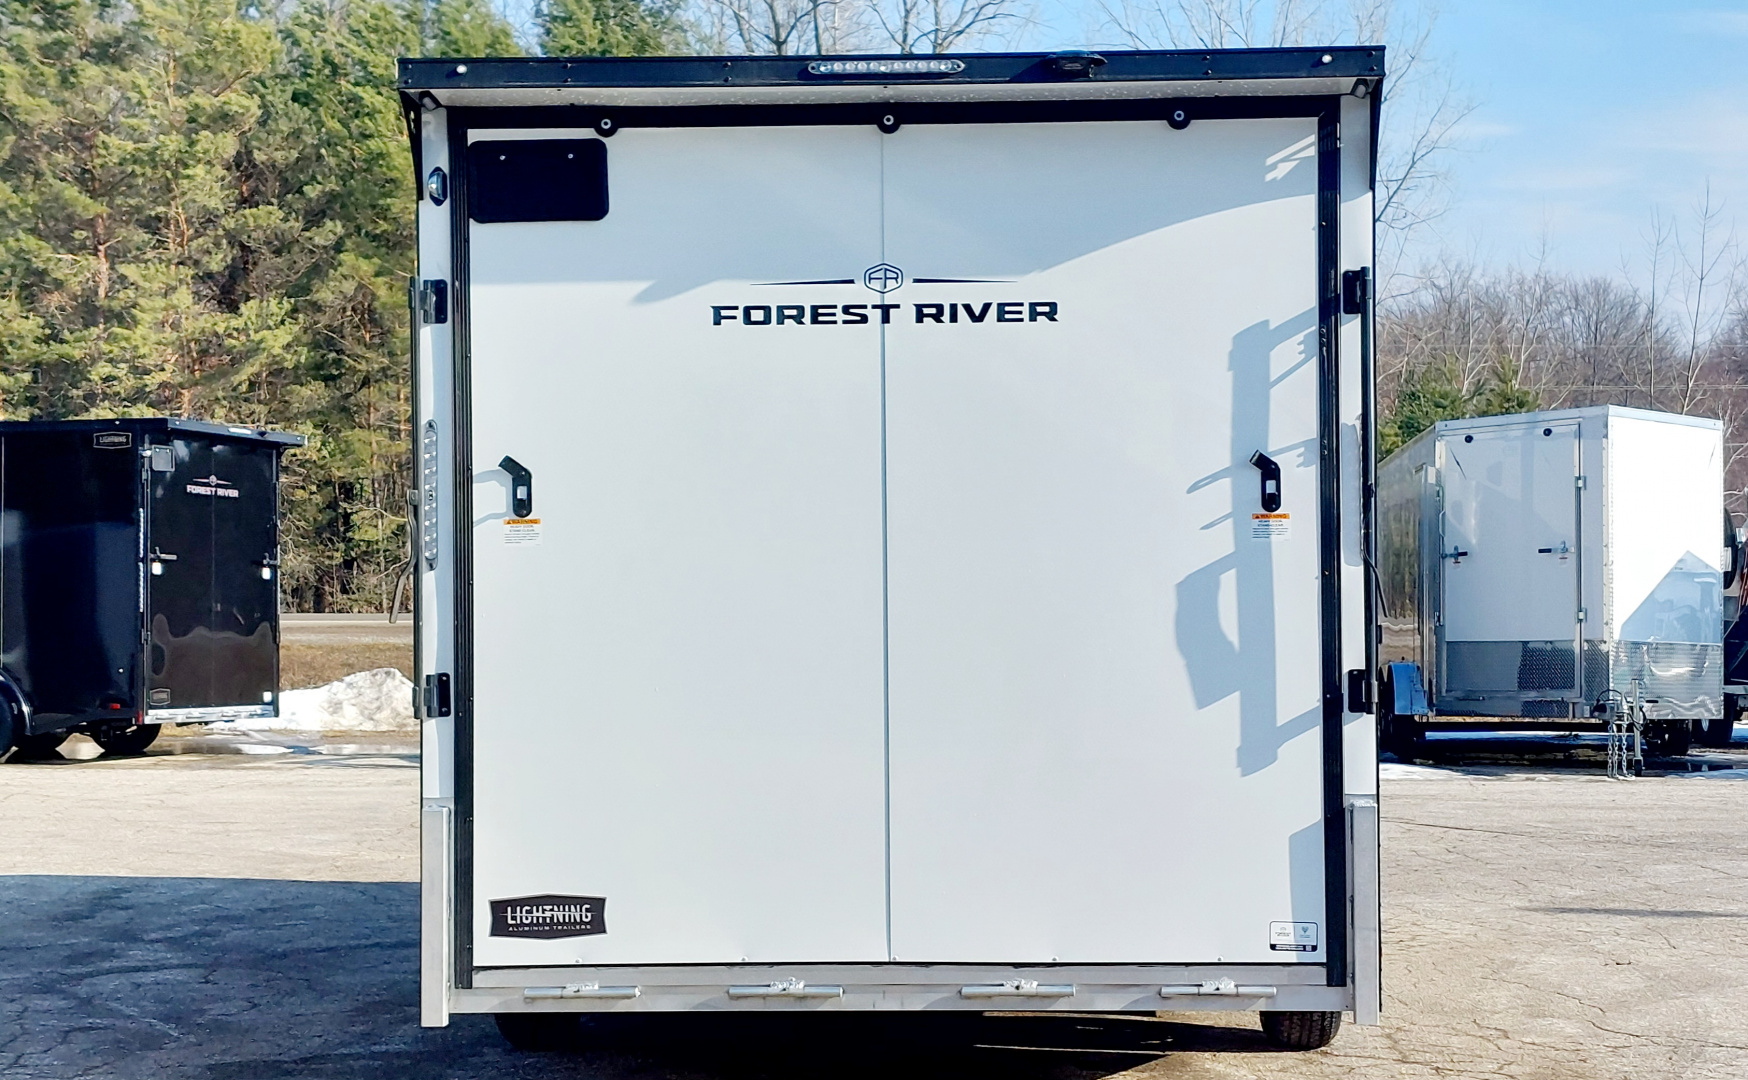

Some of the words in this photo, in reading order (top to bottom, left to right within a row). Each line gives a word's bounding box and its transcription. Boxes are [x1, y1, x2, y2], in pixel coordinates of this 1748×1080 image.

[710, 304, 900, 326] FOREST
[913, 301, 1059, 323] RIVER
[186, 484, 216, 495] FOREST
[216, 487, 239, 498] RIVER
[507, 904, 592, 925] LIGHTNING
